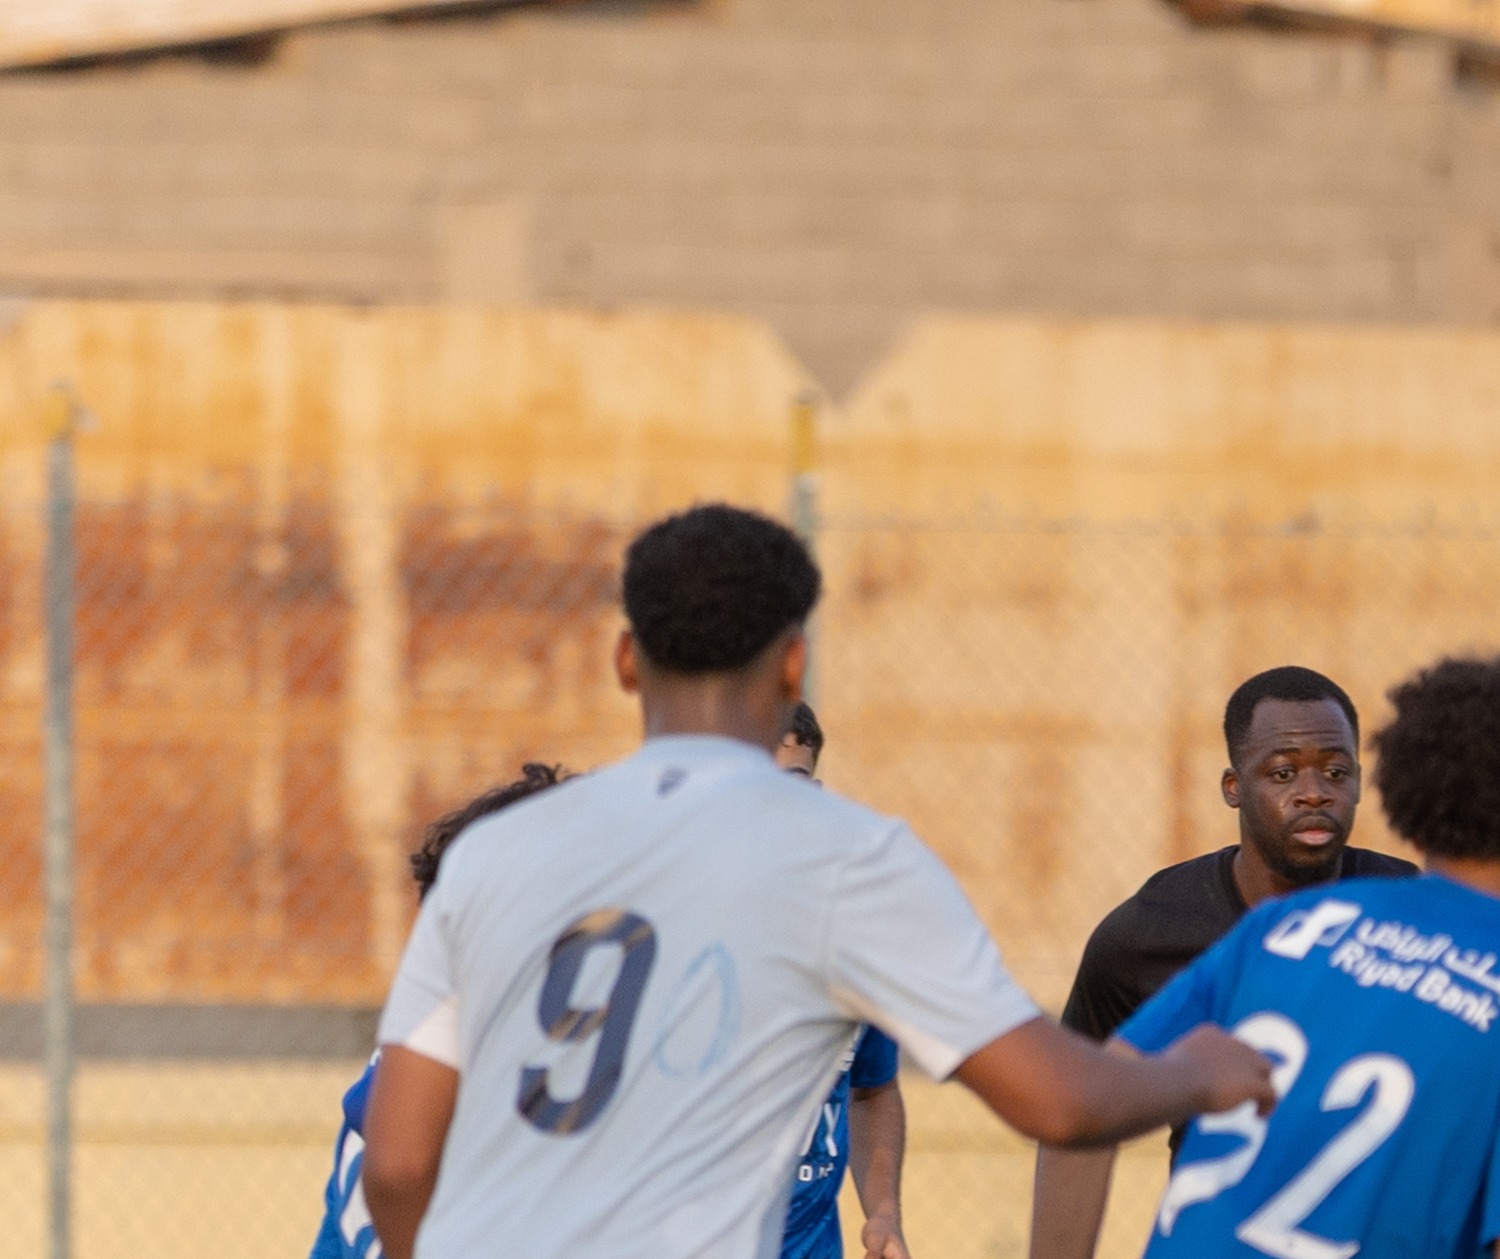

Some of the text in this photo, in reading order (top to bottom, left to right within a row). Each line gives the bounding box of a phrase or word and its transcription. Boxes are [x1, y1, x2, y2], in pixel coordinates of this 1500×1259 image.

[515, 908, 659, 1136] 9
[1329, 939, 1500, 1034] Riyad Bank
